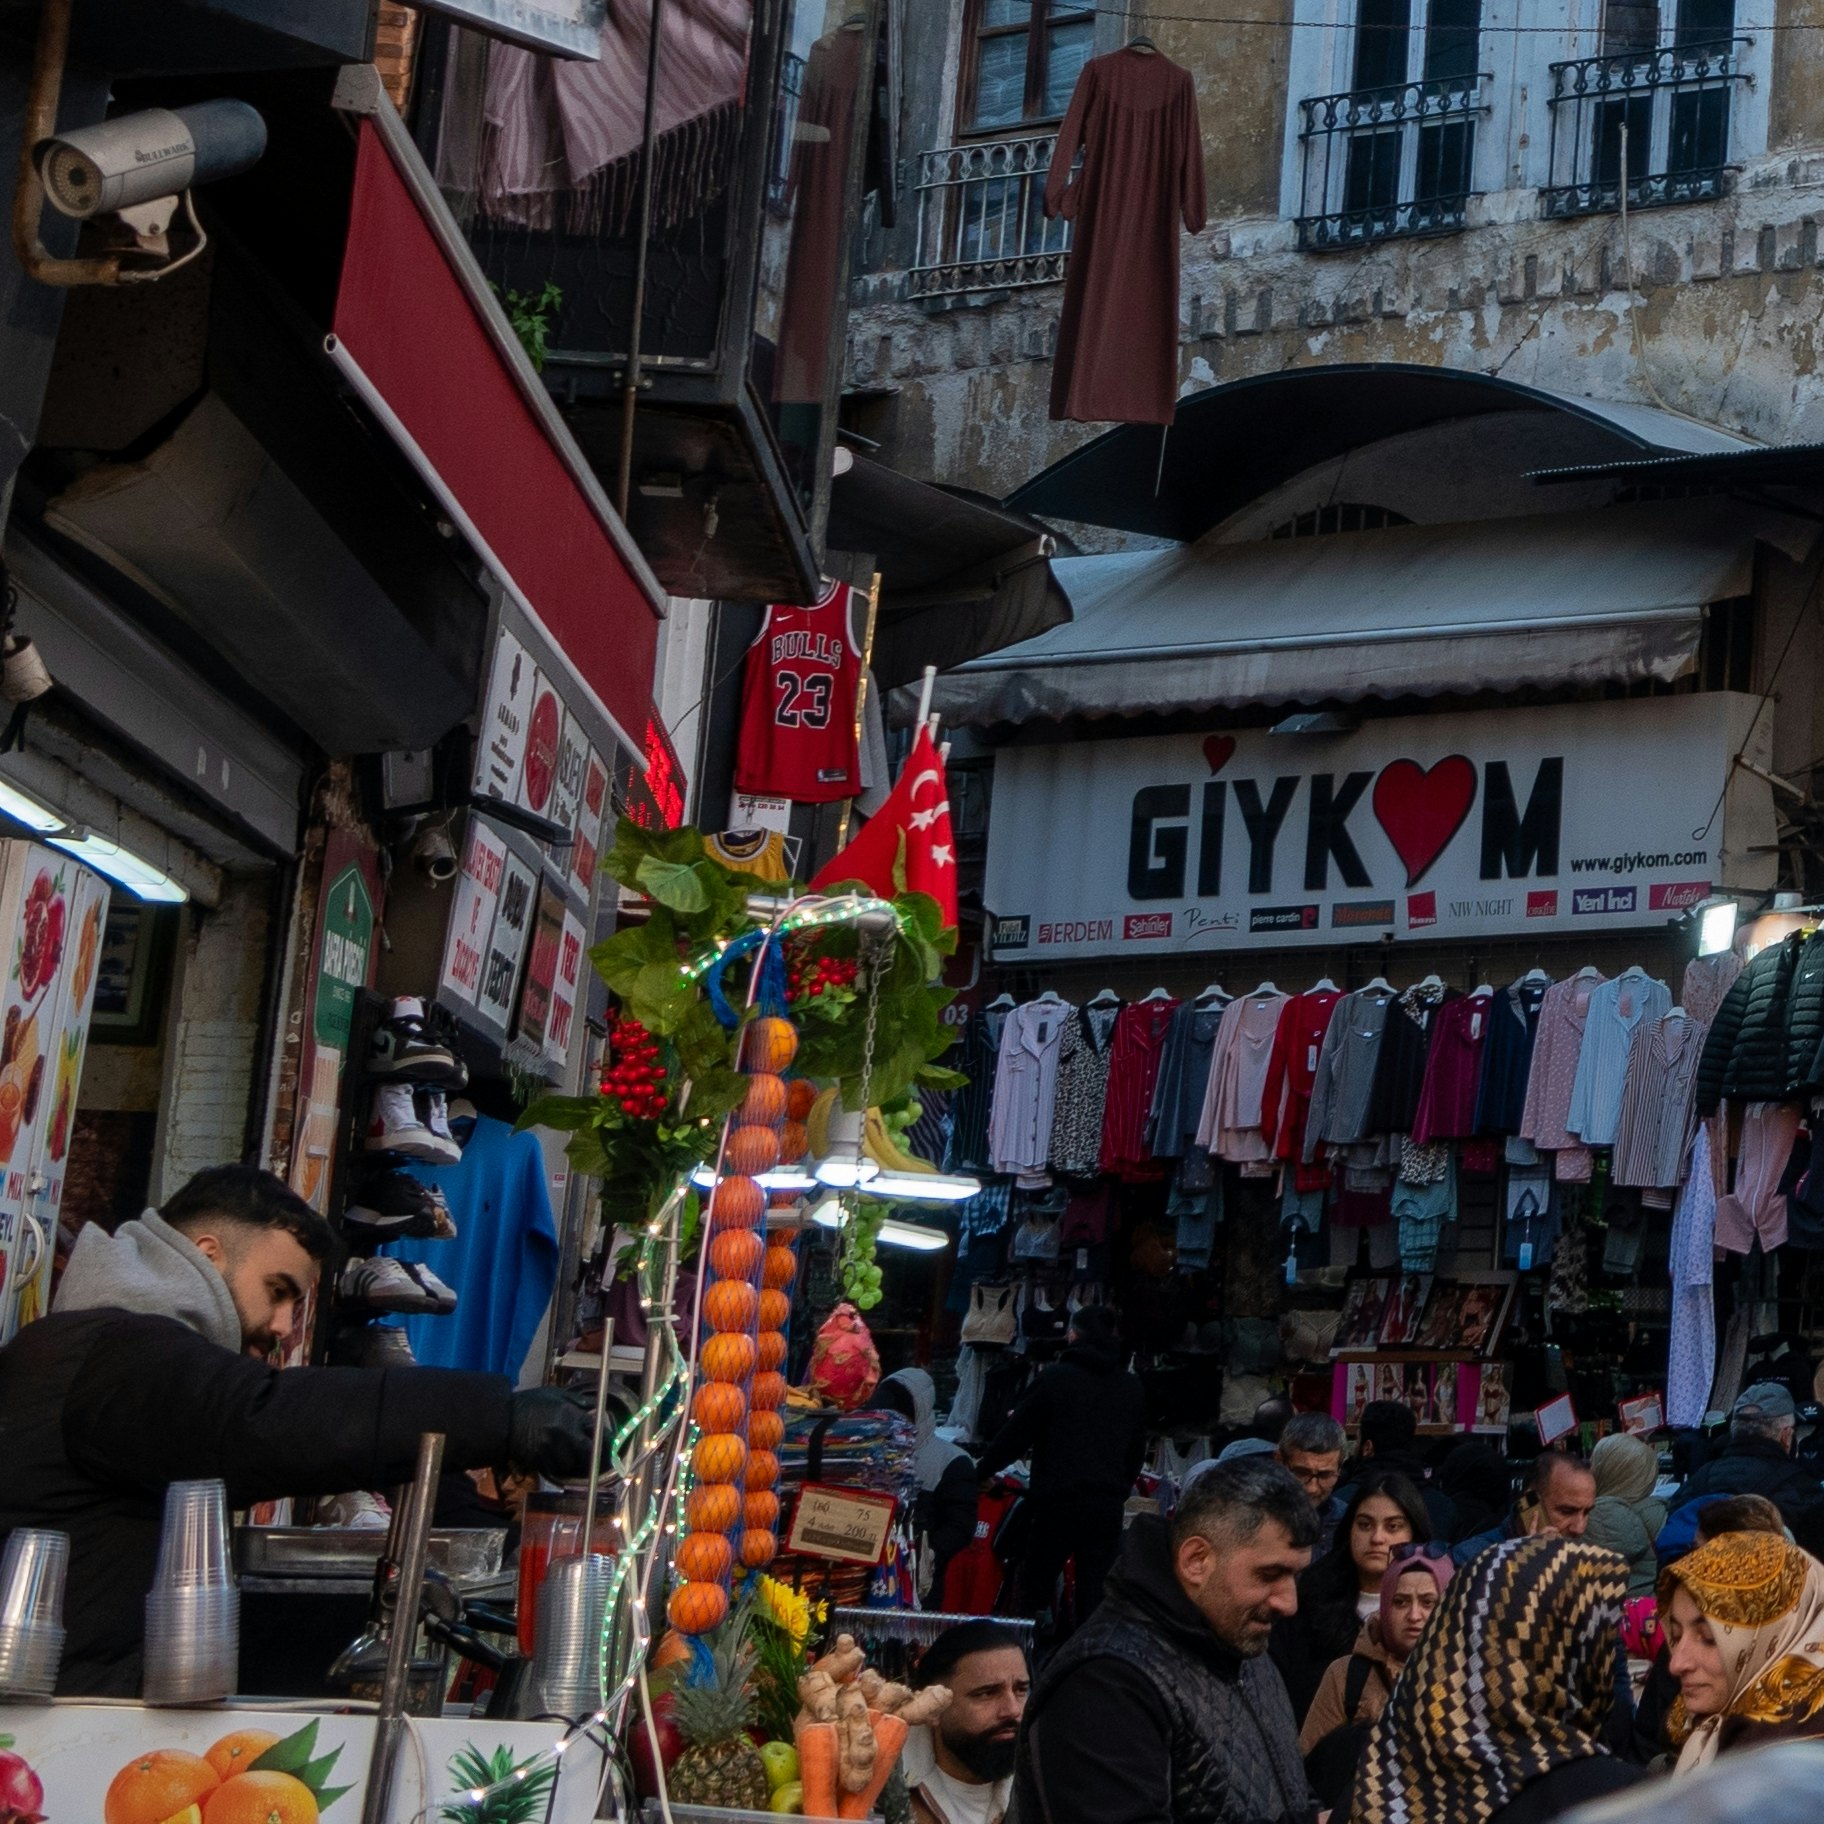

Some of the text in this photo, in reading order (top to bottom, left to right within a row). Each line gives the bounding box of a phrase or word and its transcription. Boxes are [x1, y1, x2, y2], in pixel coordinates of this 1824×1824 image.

[771, 630, 843, 670] BULLS
[774, 669, 835, 730] 23
[1571, 850, 1708, 876] www.giykom.com
[1476, 897, 1514, 917] NIGHT
[1053, 919, 1113, 944] ERDEM
